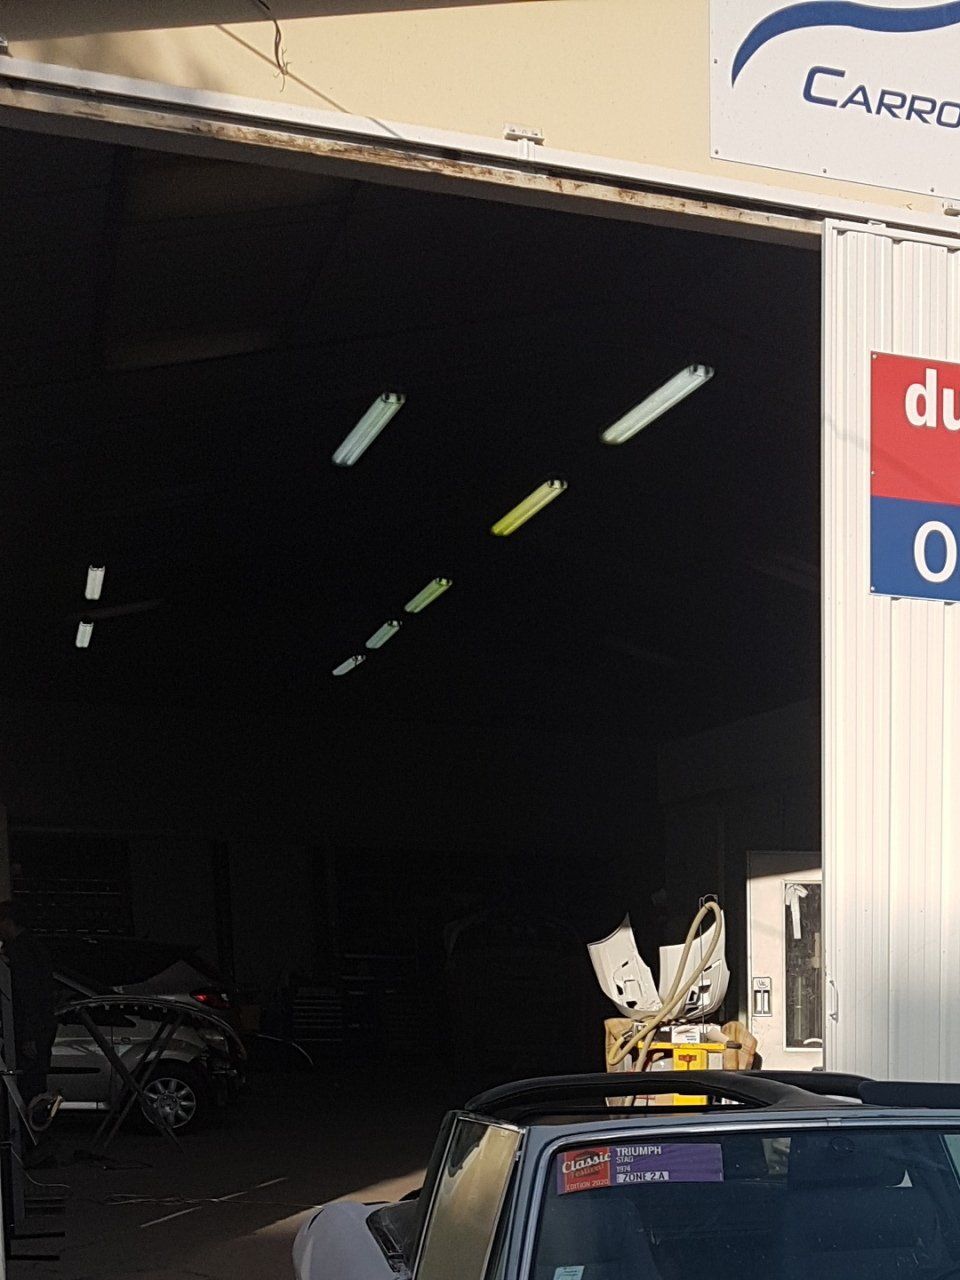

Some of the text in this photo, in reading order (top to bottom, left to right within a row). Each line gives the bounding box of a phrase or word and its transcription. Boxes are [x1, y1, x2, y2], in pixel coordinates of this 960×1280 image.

[616, 1146, 662, 1155] TRIUMPH
[562, 1151, 612, 1174] Classic
[623, 1172, 647, 1182] ZONE
